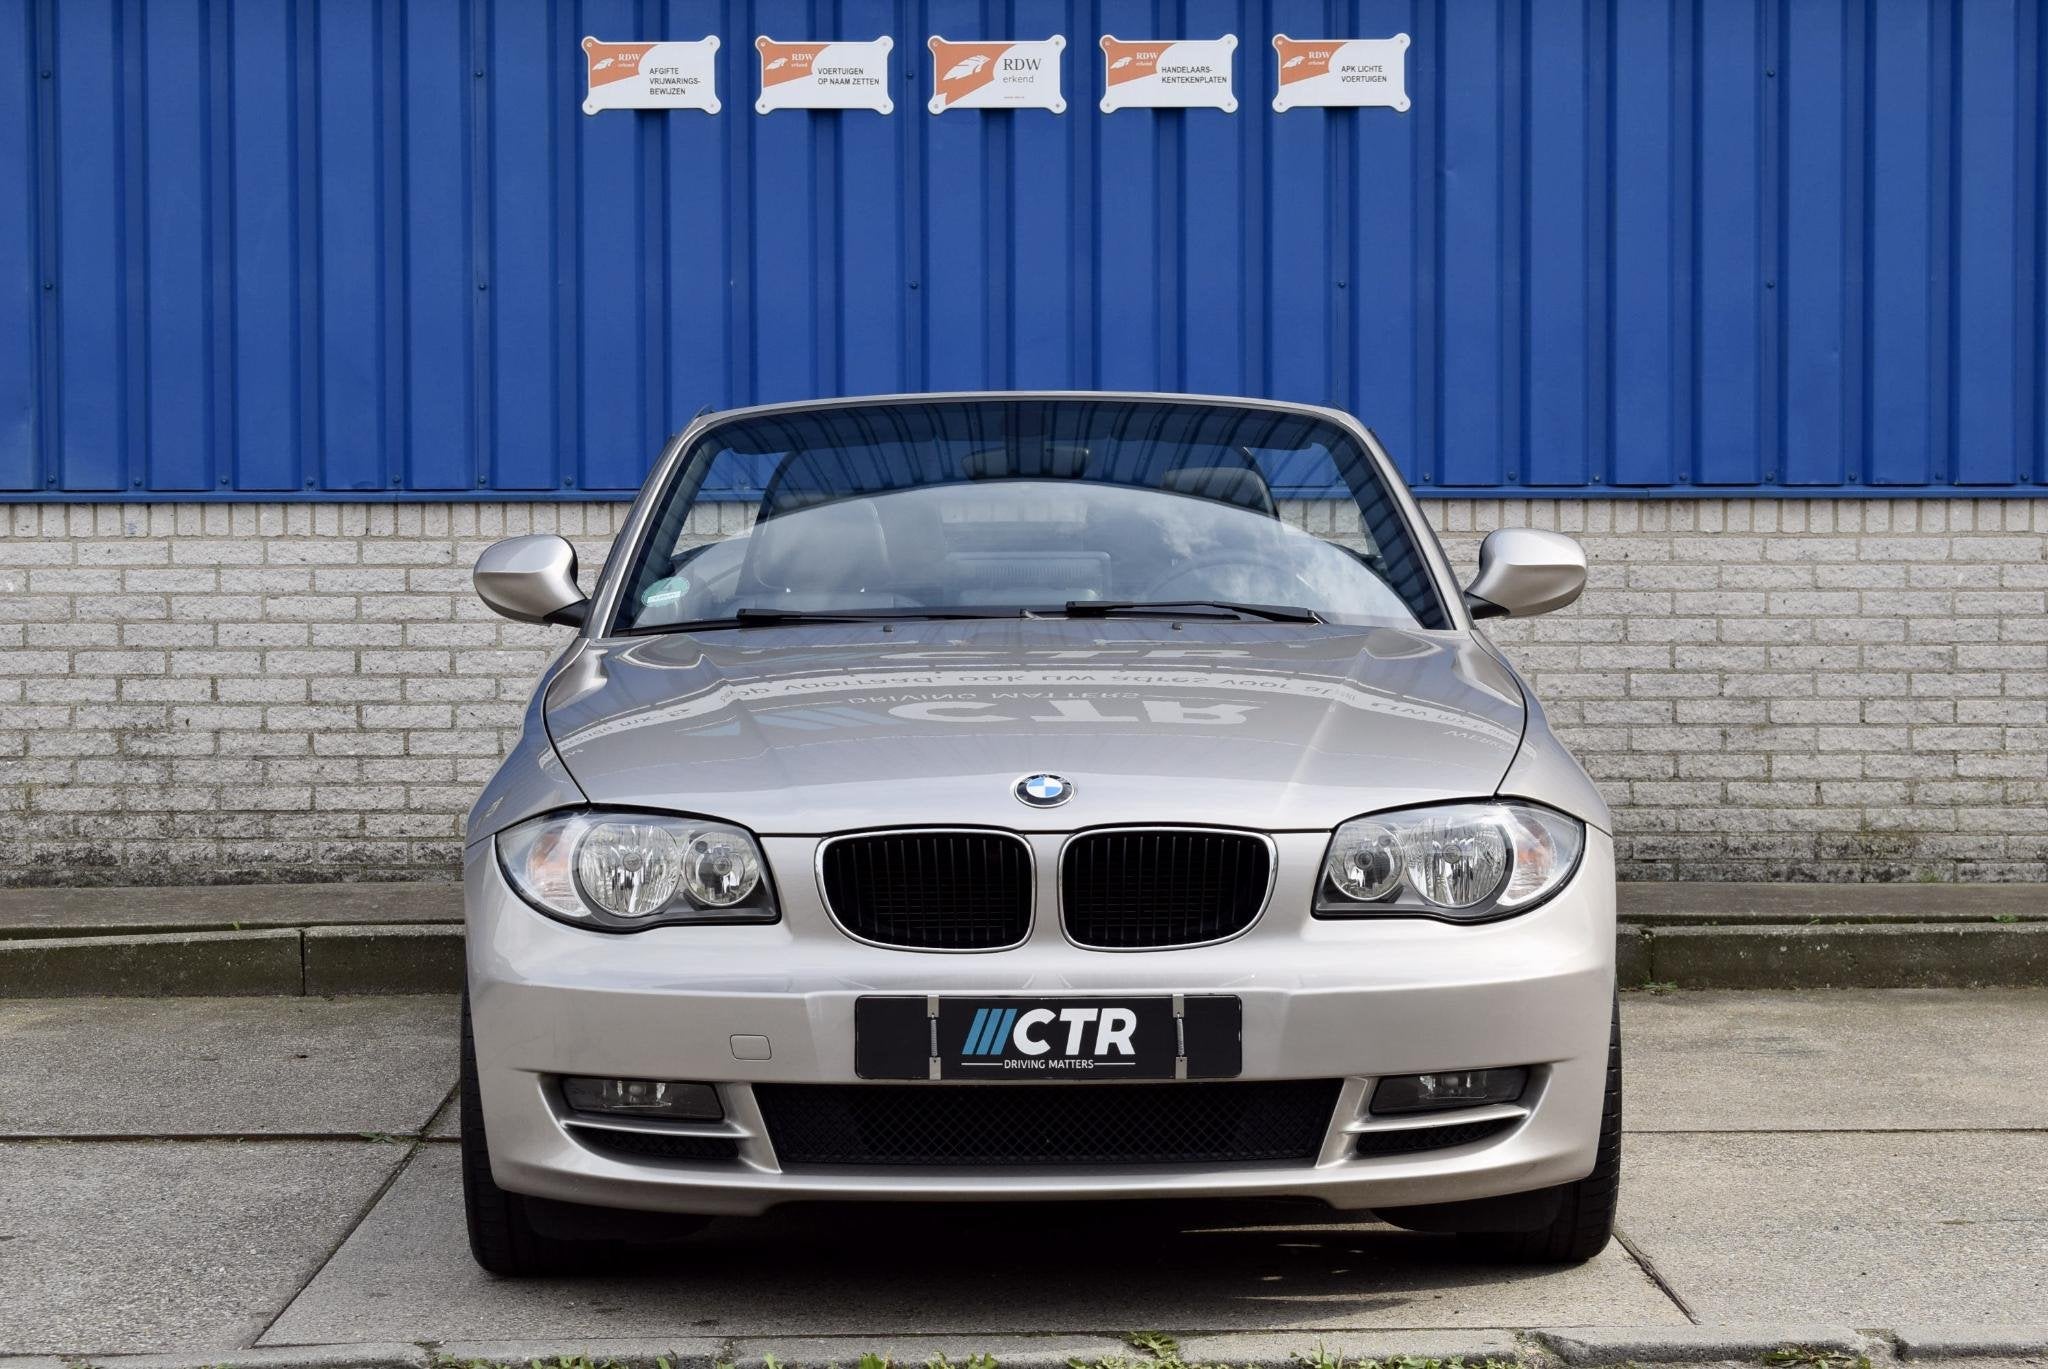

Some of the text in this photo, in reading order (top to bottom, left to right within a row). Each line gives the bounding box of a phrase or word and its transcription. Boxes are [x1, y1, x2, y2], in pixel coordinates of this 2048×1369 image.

[618, 53, 642, 62] RDW
[791, 53, 815, 61] RDW
[1136, 52, 1160, 60] RDW
[1308, 51, 1331, 59] RDW
[1003, 57, 1042, 71] RDW
[649, 67, 679, 75] AFGIFTE
[817, 67, 864, 75] VOERTUIGEN
[1161, 66, 1213, 74] HANDELAARS-
[1341, 65, 1383, 73] APK LICHTE
[649, 77, 702, 85] VRIJWARINGS-
[817, 77, 880, 86] OP NAAM ZETTEN
[1002, 75, 1034, 84] erkend
[1161, 76, 1227, 84] KENTEKENPLATEN
[1341, 75, 1387, 83] VOERTUIGEN
[649, 87, 686, 95] BEWIJZEN
[1012, 1007, 1138, 1056] CTR
[1003, 1059, 1095, 1070] DRIVING MATTERS
